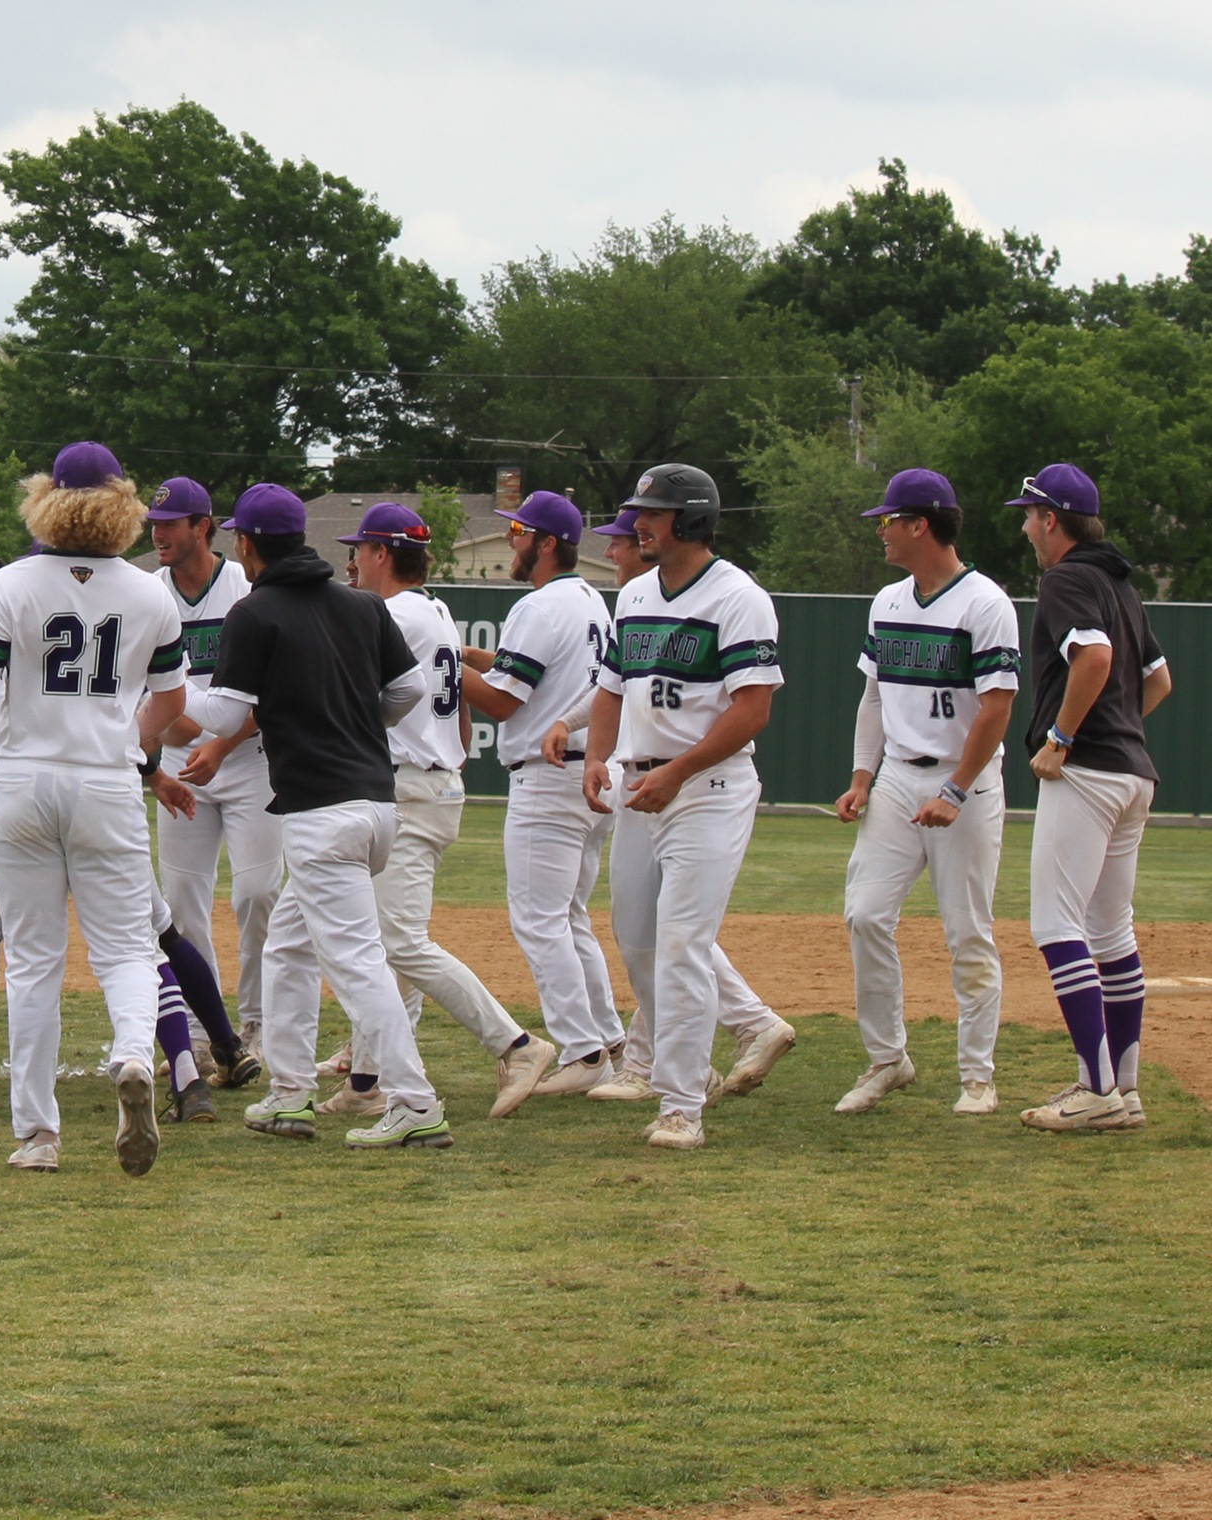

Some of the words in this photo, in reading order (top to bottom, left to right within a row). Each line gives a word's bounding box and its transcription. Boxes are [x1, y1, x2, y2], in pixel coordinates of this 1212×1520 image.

[42, 612, 122, 698] 21
[875, 637, 959, 672] RICHLAND
[649, 678, 684, 710] 25
[930, 689, 956, 720] 16
